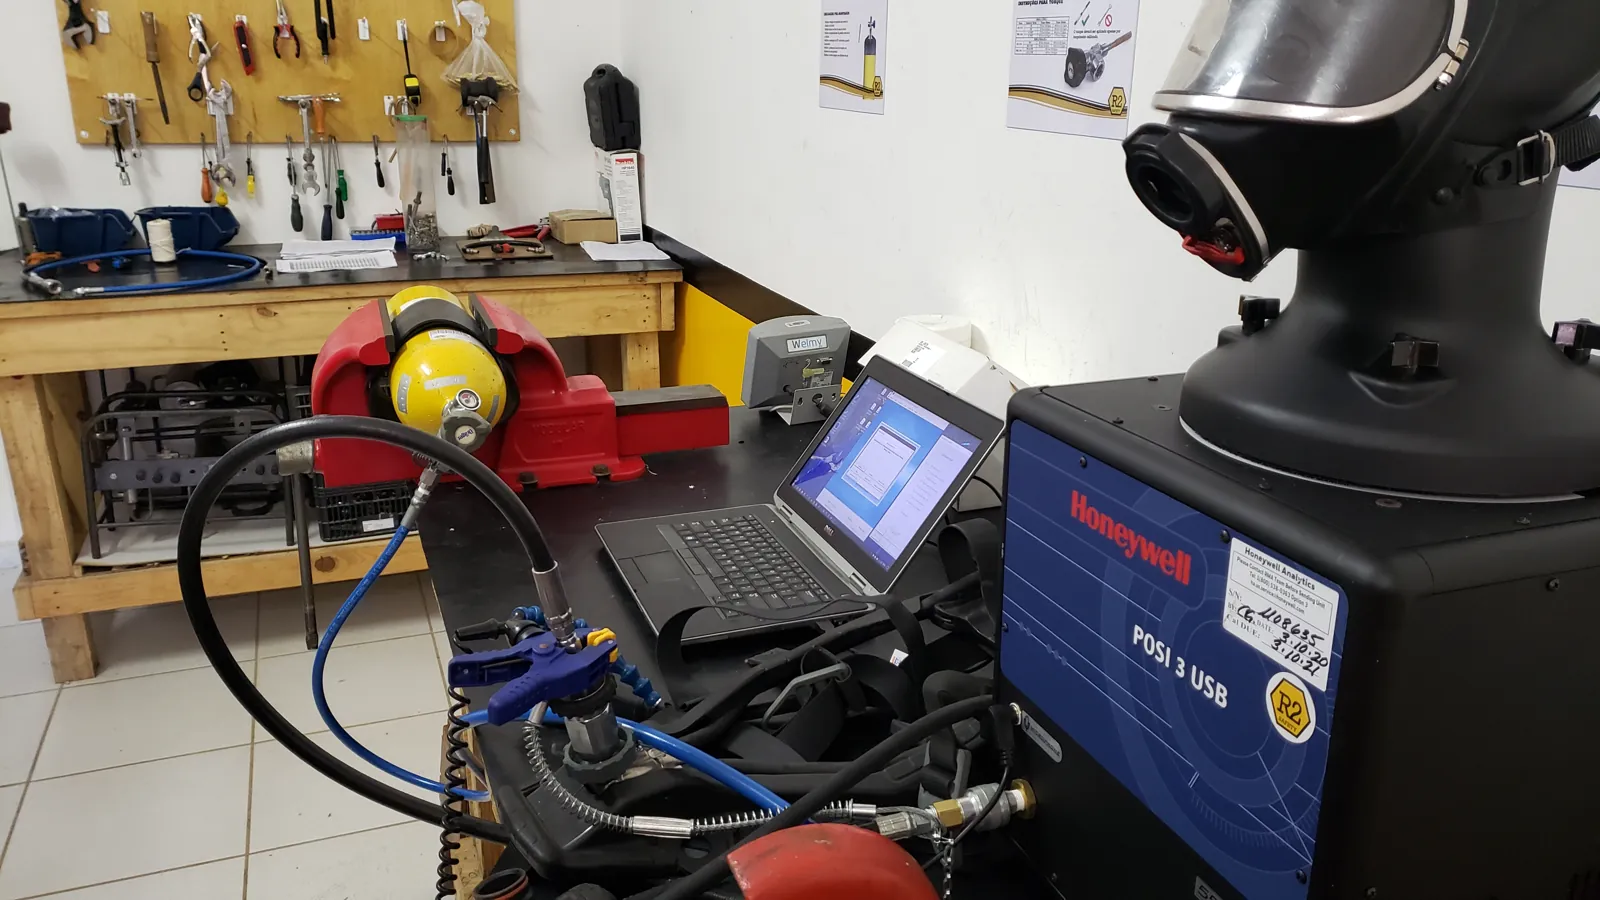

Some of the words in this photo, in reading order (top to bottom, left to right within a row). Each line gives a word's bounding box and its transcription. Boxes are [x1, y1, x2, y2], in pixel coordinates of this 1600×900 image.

[1111, 94, 1123, 107] R2
[791, 338, 822, 349] Welmy
[1070, 490, 1192, 586] Honeywell
[1237, 556, 1248, 567] Please
[1250, 563, 1264, 575] Contact
[1274, 576, 1285, 586] Team
[1285, 582, 1298, 594] Before
[1300, 590, 1316, 604] Sending
[1316, 598, 1326, 608] Unit
[1244, 547, 1280, 571] Honeywell
[1282, 566, 1315, 590] Analytics
[1291, 594, 1305, 606] Option
[1226, 614, 1238, 626] Cal
[1240, 622, 1260, 638] DUE:
[1256, 618, 1274, 634] DATE:
[1133, 624, 1171, 668] POSI
[1176, 656, 1185, 678] 3
[1190, 664, 1228, 708] USB
[1277, 690, 1302, 725] R2
